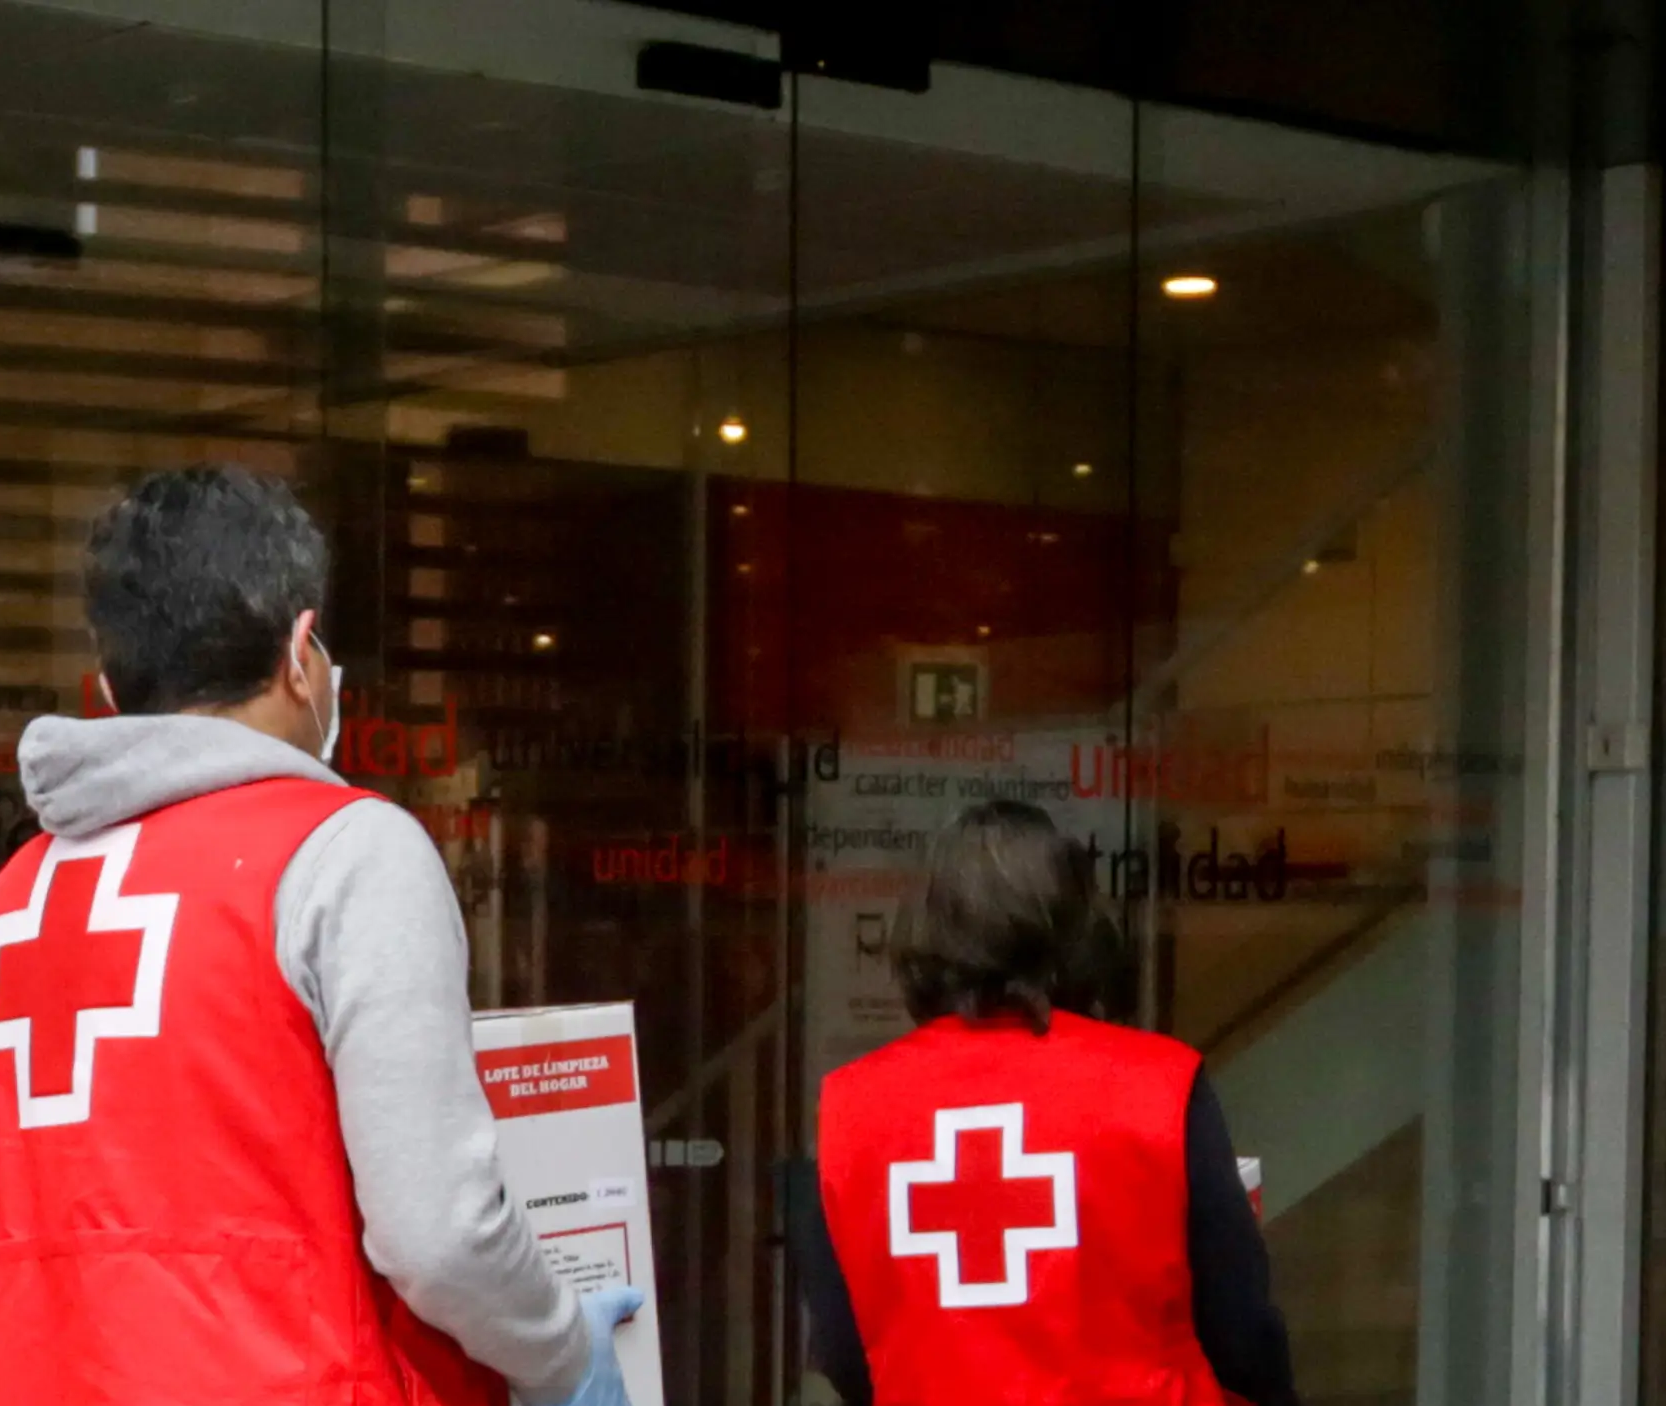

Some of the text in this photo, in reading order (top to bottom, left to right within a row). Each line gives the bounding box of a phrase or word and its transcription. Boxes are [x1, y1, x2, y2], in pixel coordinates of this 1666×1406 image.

[592, 834, 729, 884] unidad
[484, 1055, 610, 1084] LOTE DE LIMPIEZA
[510, 1075, 588, 1098] DEL HOGAR
